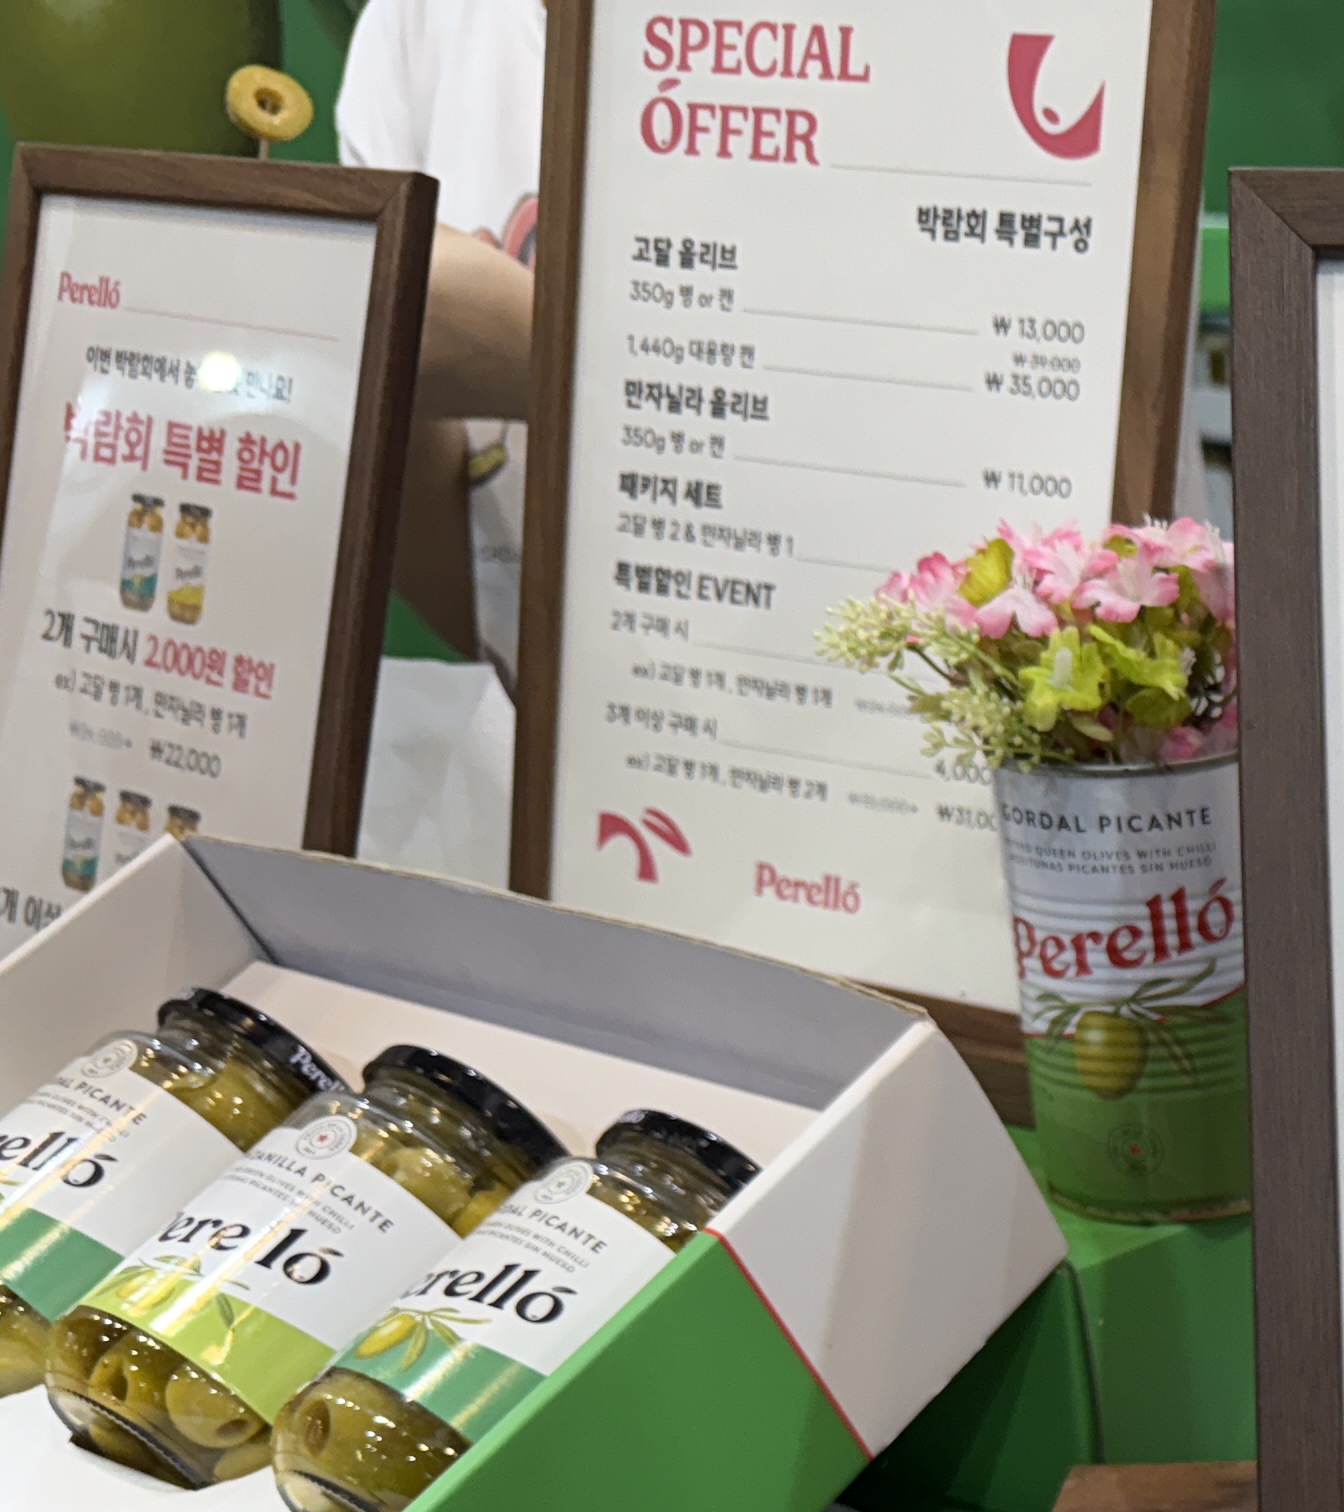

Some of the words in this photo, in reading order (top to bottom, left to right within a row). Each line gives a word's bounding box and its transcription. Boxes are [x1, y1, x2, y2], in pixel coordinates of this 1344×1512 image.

[643, 16, 870, 83] SPECIAL
[917, 205, 986, 244] 박람회
[995, 210, 1092, 254] 특별구성
[632, 237, 673, 266] 고달
[677, 241, 738, 271] 올리브
[58, 272, 120, 309] Perelló
[629, 281, 674, 309] 350g
[627, 335, 684, 363] 1,440g
[1018, 316, 1084, 344] 13,000
[624, 379, 703, 416] 만자닐라
[708, 386, 769, 421] 올리브
[1009, 374, 1080, 401] 35,000
[161, 422, 226, 491] 특별
[236, 432, 302, 500] 할인
[618, 472, 680, 506] 패키지
[683, 477, 723, 509] 세트
[1007, 471, 1072, 499] 11,000
[614, 560, 693, 600] 특별할인
[699, 571, 776, 610] EVENT
[41, 609, 74, 650] 2개
[80, 618, 139, 666] 구매시
[231, 652, 275, 699] 할인
[1002, 804, 1086, 834] GORDAL
[1100, 806, 1212, 834] PICANTE
[753, 861, 860, 915] Perelló
[1012, 877, 1234, 981] Perelló
[309, 1170, 395, 1235] PICANTE
[528, 1202, 608, 1255] PICANTE
